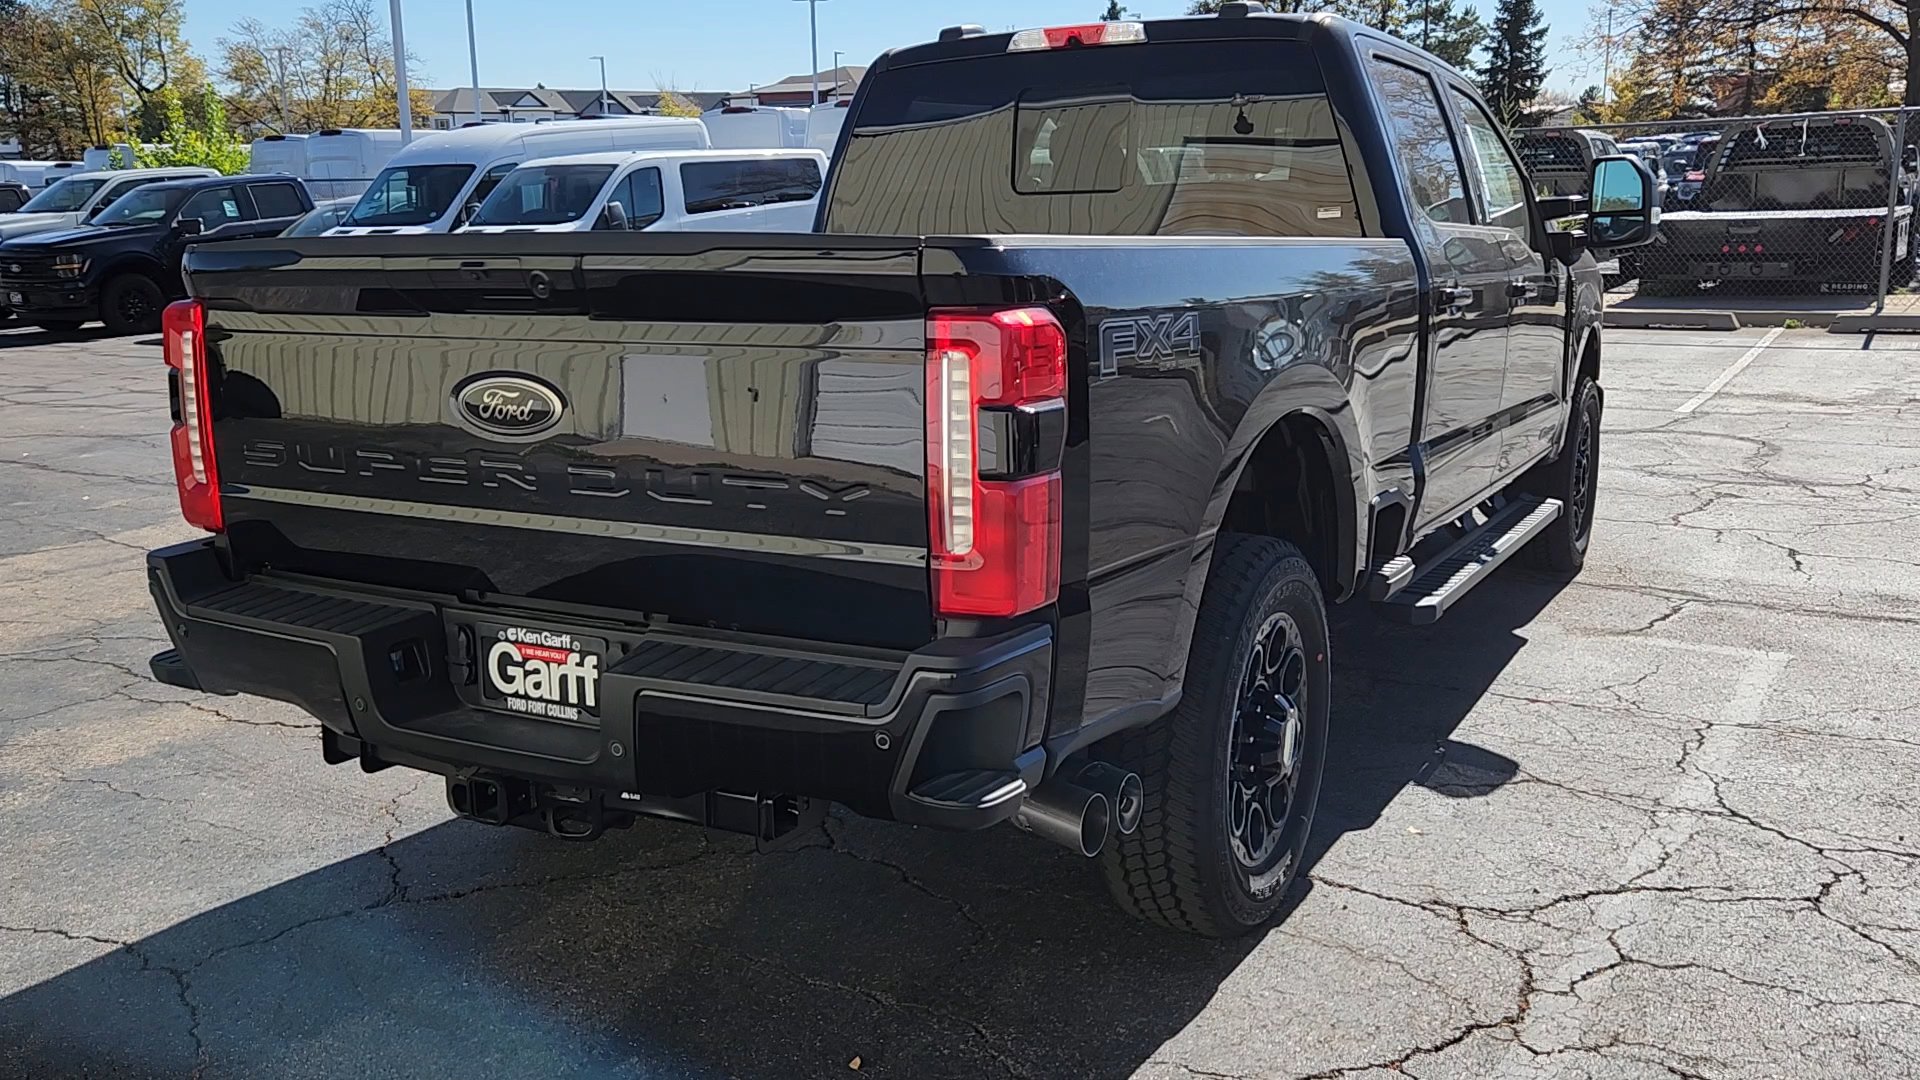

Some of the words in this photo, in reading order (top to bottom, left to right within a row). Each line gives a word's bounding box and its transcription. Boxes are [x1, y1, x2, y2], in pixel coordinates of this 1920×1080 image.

[1099, 312, 1201, 380] FX4
[479, 388, 534, 421] Ford
[243, 439, 537, 491] SUPER
[567, 464, 871, 515] DUTY
[488, 641, 598, 707] Garff
[507, 697, 527, 711] FORD
[528, 700, 546, 716] FORT
[547, 703, 578, 720] COLLINS
